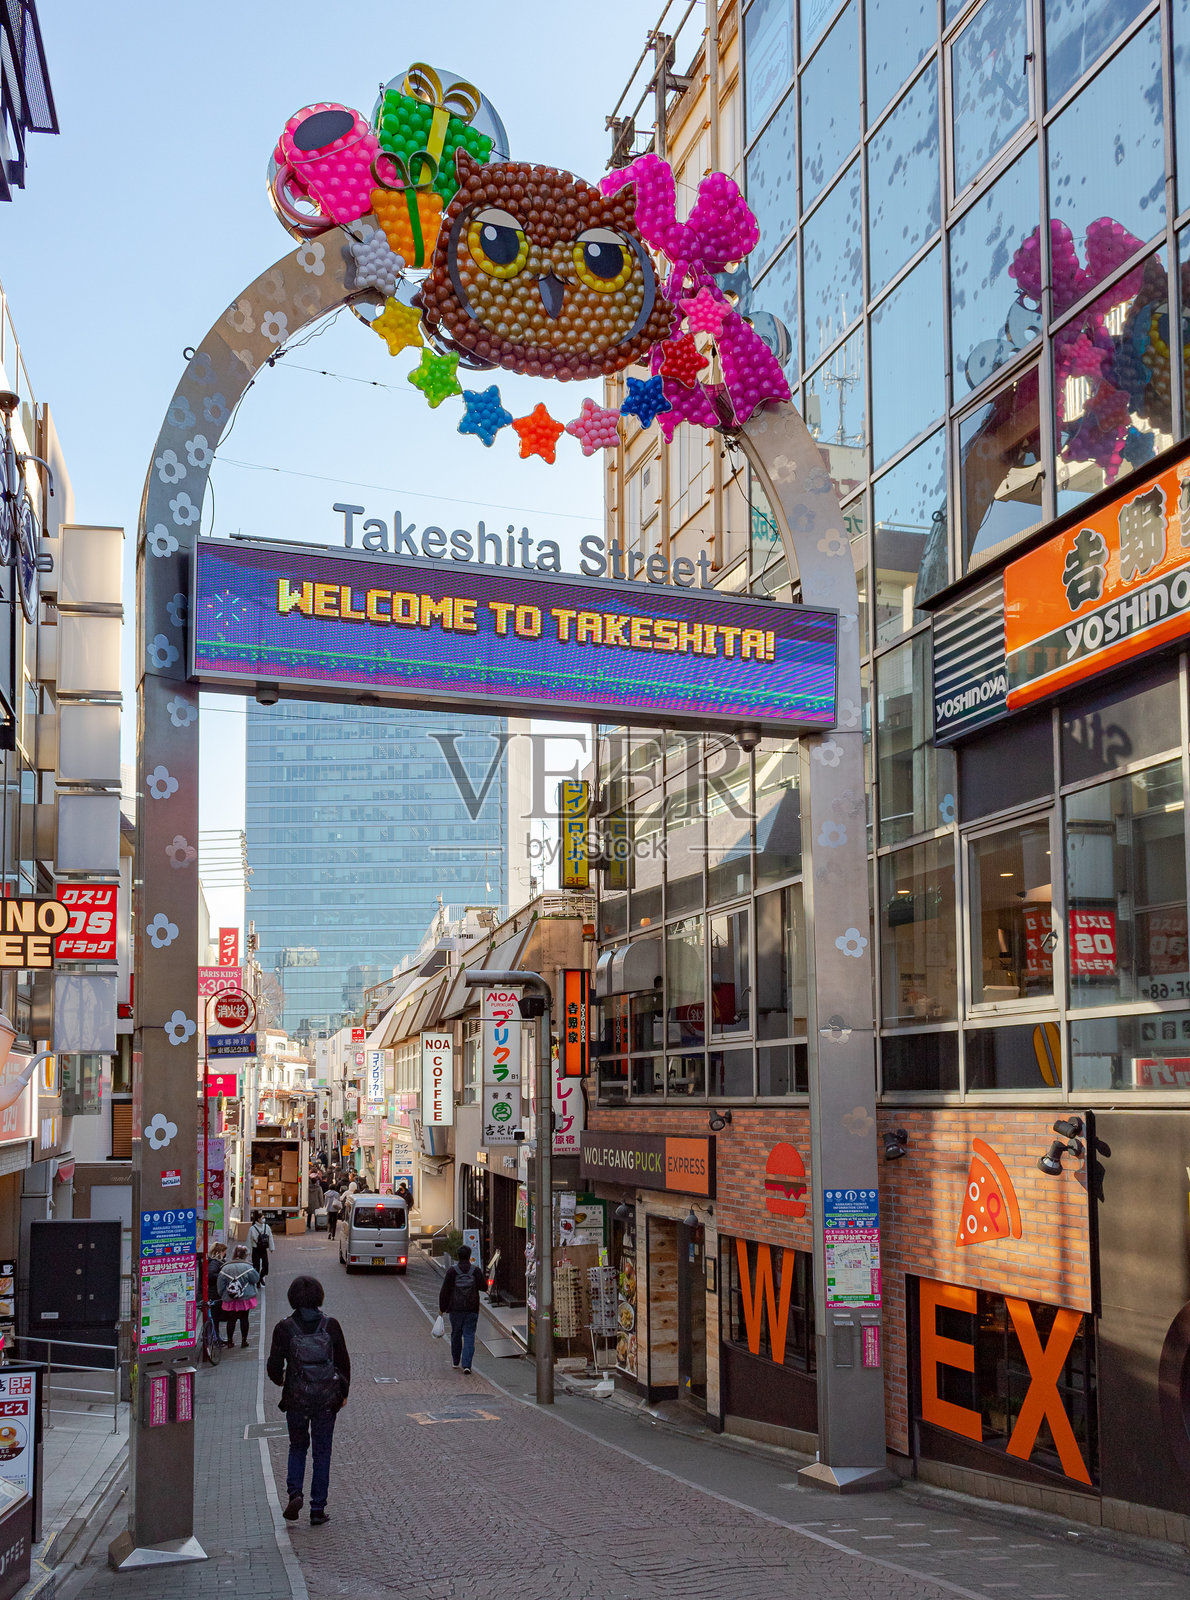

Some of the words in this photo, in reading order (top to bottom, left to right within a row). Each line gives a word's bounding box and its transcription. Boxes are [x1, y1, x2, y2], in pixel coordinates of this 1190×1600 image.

[333, 502, 561, 572] Takeshita
[579, 534, 714, 589] Street
[278, 578, 477, 631] WELCOME
[489, 601, 542, 639] TO
[552, 608, 776, 660] TAKESHITA!
[566, 877, 586, 885] 3F
[63, 890, 112, 905] クスリ
[58, 940, 114, 953] ドラッグ
[200, 969, 220, 978] PARIS
[199, 979, 238, 995] ¥300
[486, 992, 518, 1002] NOA
[218, 1004, 247, 1018] 消火栓
[425, 1040, 451, 1050] NOA
[492, 1009, 513, 1082] プリクラ
[372, 1052, 380, 1096] コインロッカー
[433, 1056, 443, 1121] COFFEE
[555, 1135, 575, 1145] 原宿
[584, 1146, 634, 1170] WOLFGANG
[635, 1150, 662, 1173] PUCK
[667, 1156, 706, 1176] EXPRESS
[141, 1260, 195, 1272] 竹下通り公式マップ
[736, 1238, 796, 1366] W
[10, 1377, 31, 1388] BF
